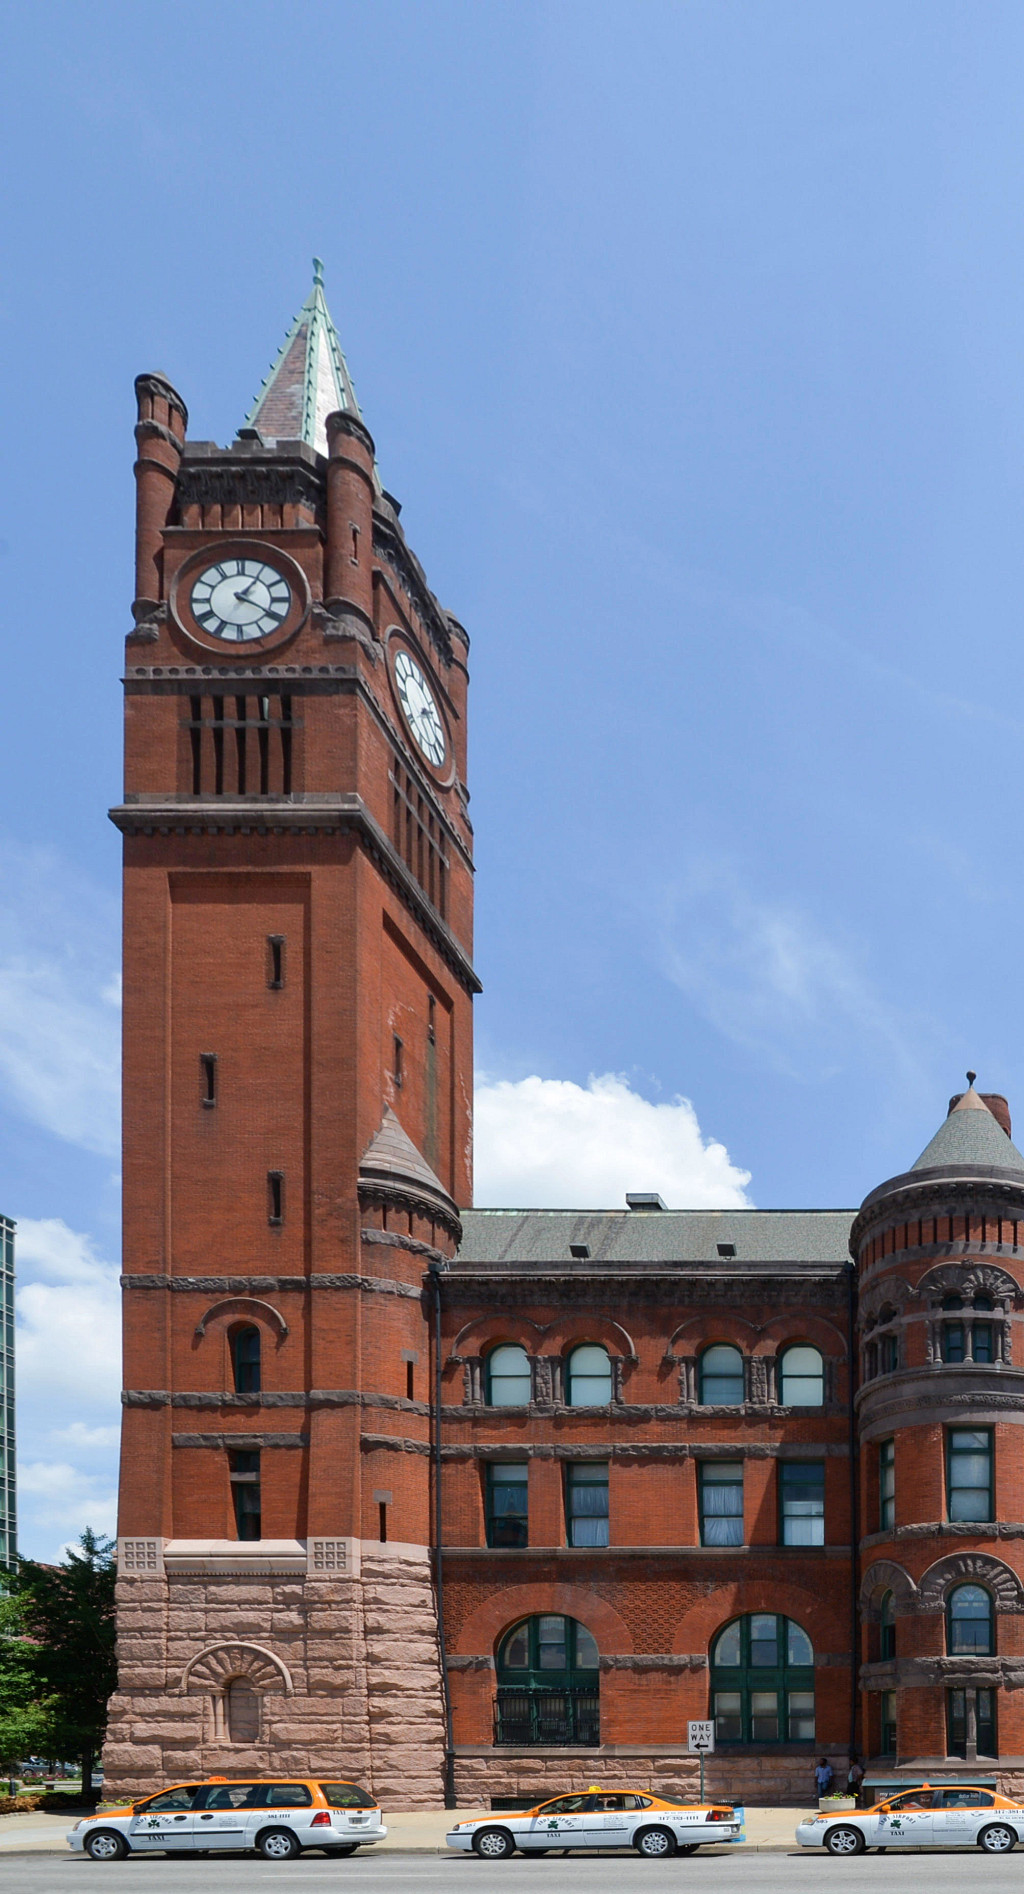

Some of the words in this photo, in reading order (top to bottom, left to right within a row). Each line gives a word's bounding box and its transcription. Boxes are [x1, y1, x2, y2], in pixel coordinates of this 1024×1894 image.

[149, 1814, 172, 1825] AIRPORT
[552, 1816, 575, 1829] AIRPORT
[892, 1814, 916, 1825] AIRPORT
